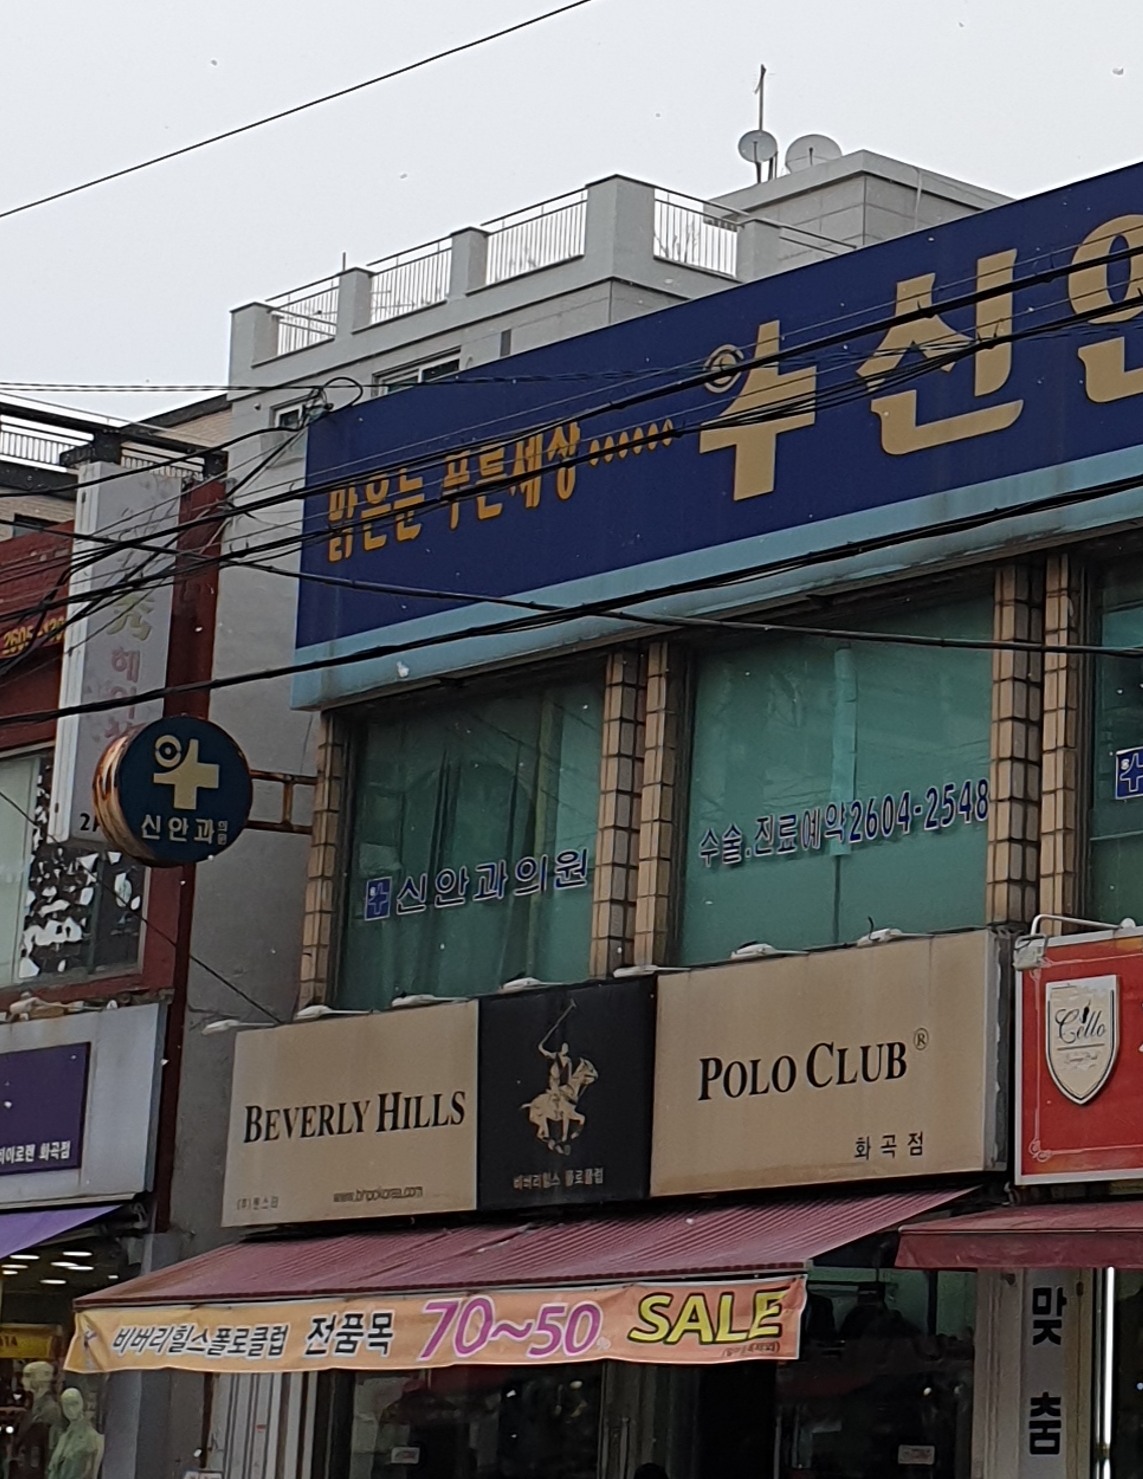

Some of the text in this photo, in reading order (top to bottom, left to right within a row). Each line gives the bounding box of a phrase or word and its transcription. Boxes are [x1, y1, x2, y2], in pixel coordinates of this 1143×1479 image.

[441, 420, 583, 531] 푸른세상
[396, 847, 589, 913] 신안과의원
[1054, 1007, 1106, 1044] Cello
[39, 1140, 71, 1161] 화곡점
[853, 1130, 926, 1161] 화곡점
[112, 1323, 289, 1359] 비버리힐스폴로클럽
[305, 1311, 395, 1357] 전품목
[627, 1285, 787, 1346] SALE
[1029, 1287, 1067, 1456] 맞춤
